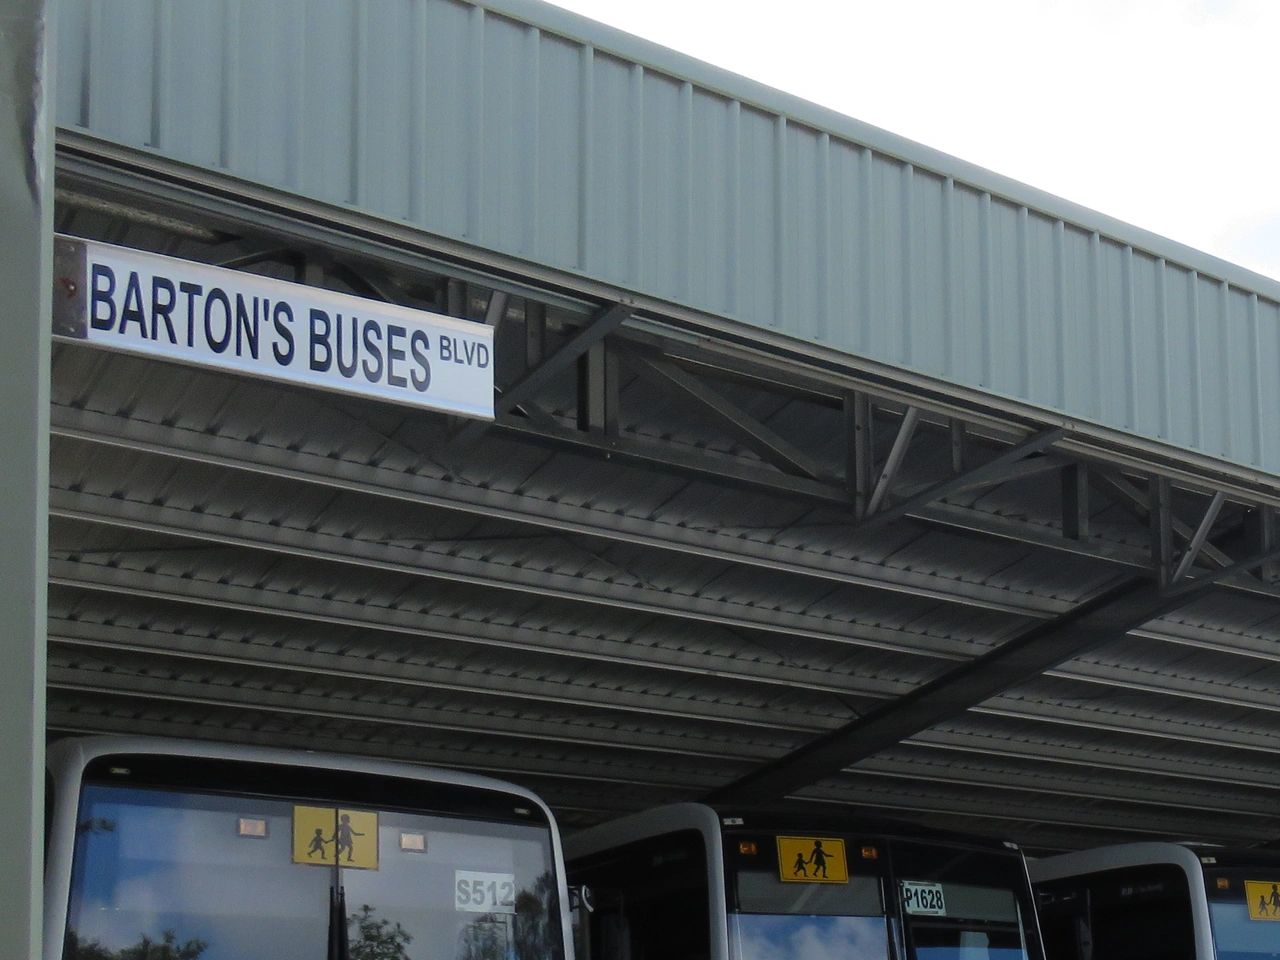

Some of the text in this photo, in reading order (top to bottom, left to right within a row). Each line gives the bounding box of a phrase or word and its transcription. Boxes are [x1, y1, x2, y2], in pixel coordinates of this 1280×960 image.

[91, 263, 490, 393] BARTON'S BUSES BLVD
[456, 879, 514, 906] S512
[904, 887, 944, 910] P1628
